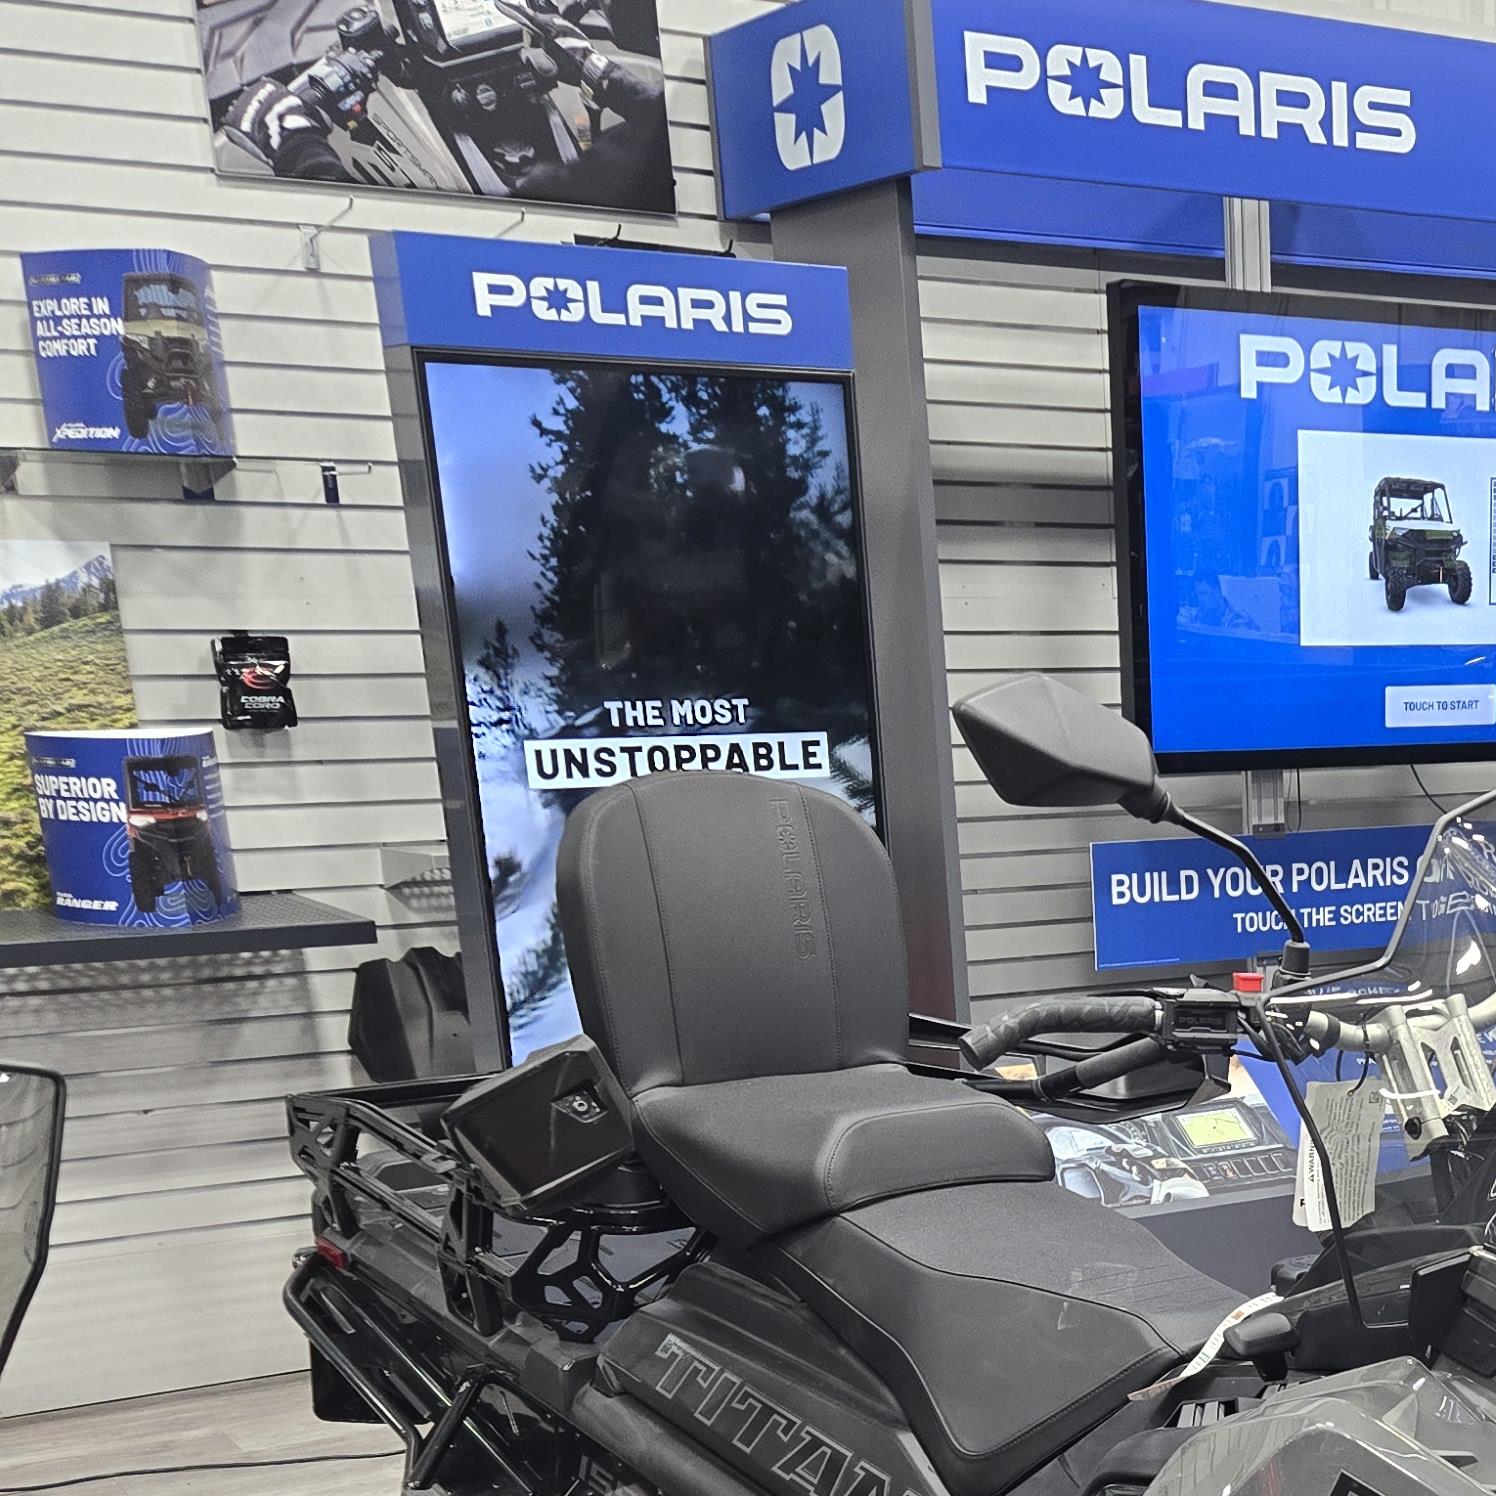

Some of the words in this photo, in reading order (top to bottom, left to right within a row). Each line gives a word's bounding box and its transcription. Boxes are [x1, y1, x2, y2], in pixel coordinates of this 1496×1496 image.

[962, 29, 1417, 154] POLARIS
[32, 298, 90, 318] EXPLORE
[91, 297, 110, 315] IN
[471, 271, 793, 335] POLARIS
[36, 317, 125, 337] ALL-SEASON
[38, 338, 98, 358] COMFORT
[604, 699, 664, 727] THE
[671, 698, 750, 726] MOST
[1403, 701, 1434, 711] TOUCH
[1436, 700, 1448, 710] TO
[1450, 699, 1480, 710] START
[534, 739, 823, 780] UNSTOPPABLE
[34, 774, 119, 800] SUPERIOR
[38, 799, 55, 820] BY
[56, 802, 127, 823] DESIGN
[1110, 869, 1200, 906] BUILD
[1206, 864, 1285, 899] YOUR
[1291, 856, 1410, 893] POLARIS
[1232, 909, 1296, 934] TOUC
[1300, 906, 1336, 928] THE
